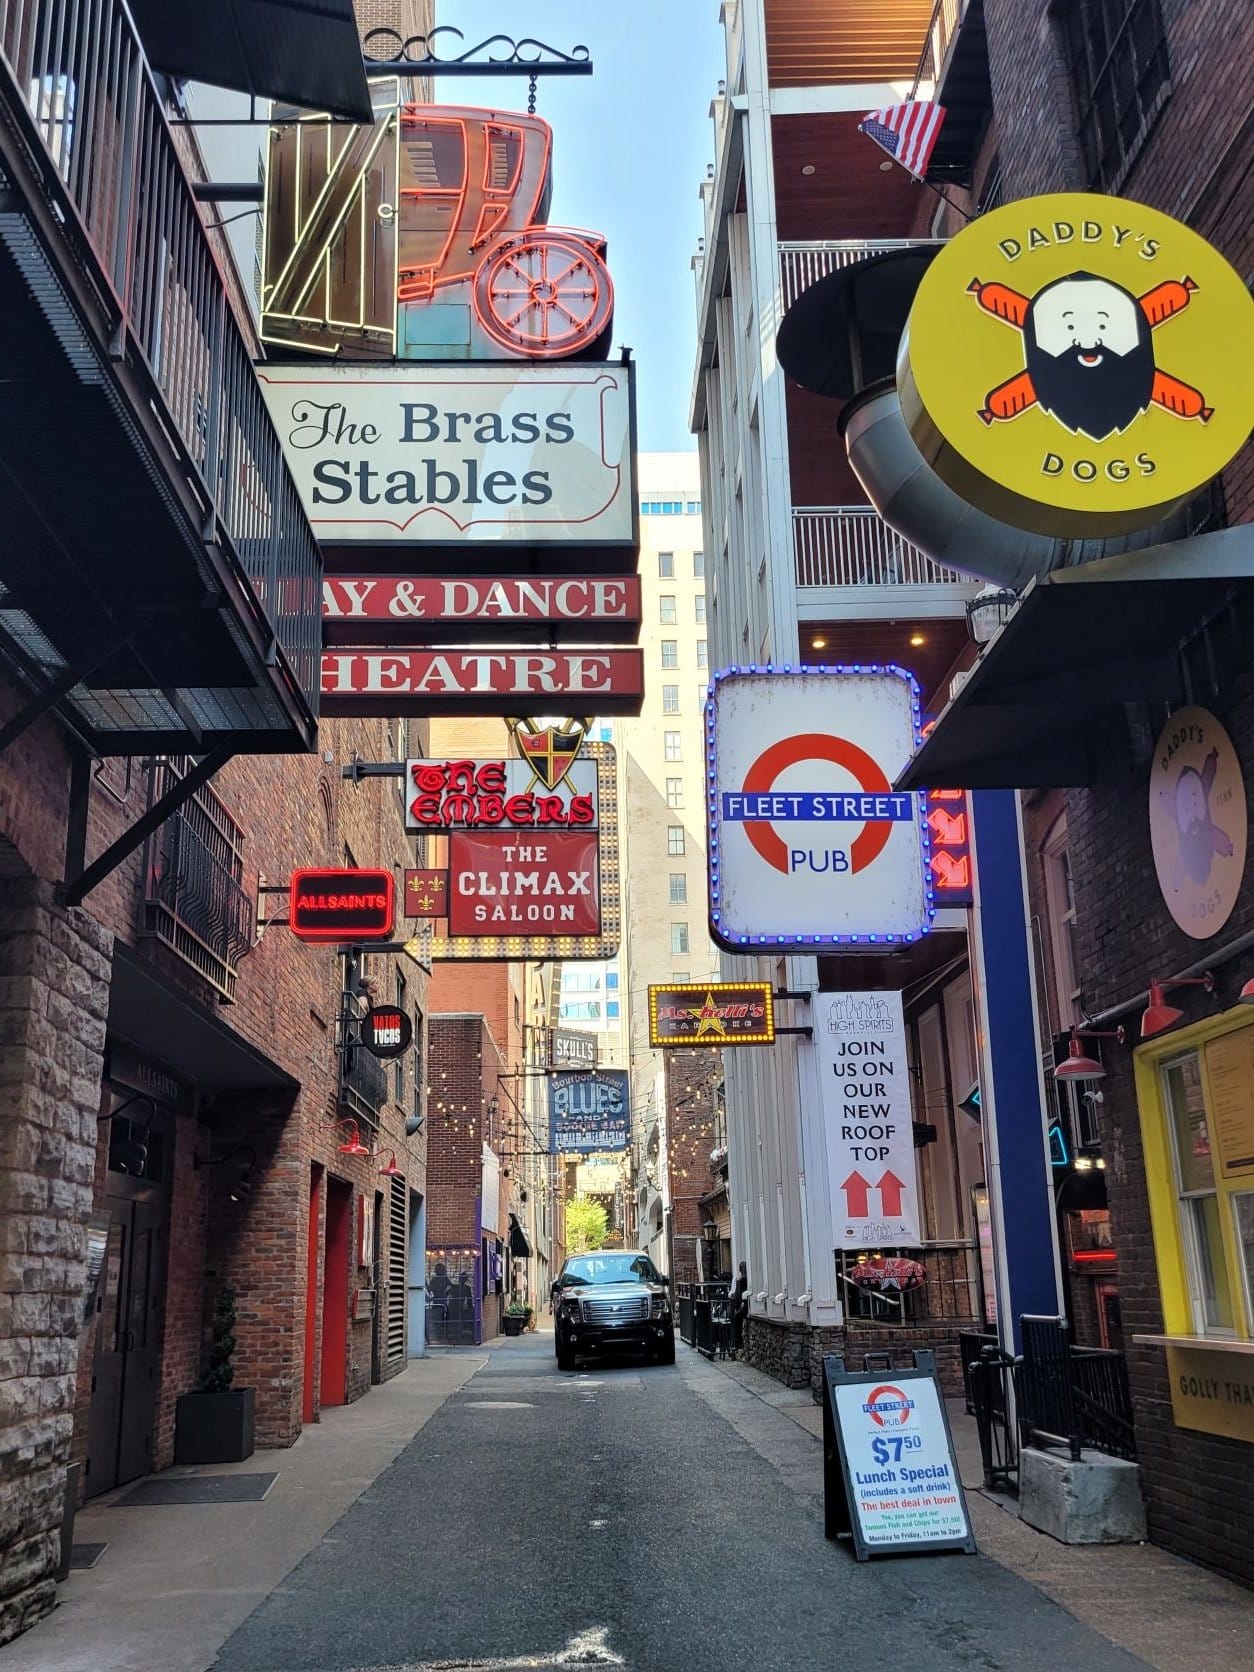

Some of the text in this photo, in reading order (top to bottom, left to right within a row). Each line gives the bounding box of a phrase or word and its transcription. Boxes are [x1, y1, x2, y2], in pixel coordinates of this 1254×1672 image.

[997, 221, 1161, 262] DADDY'S
[289, 400, 574, 449] The Brass
[1041, 452, 1156, 483] DOGS
[312, 458, 553, 505] Stables
[388, 581, 425, 617] &
[440, 581, 626, 617] DANCE
[308, 655, 612, 692] HEATRE
[1161, 724, 1204, 771] DADDY'S
[729, 797, 905, 817] FLEET STREET
[502, 846, 547, 862] THE
[791, 850, 849, 873] PUB
[458, 872, 591, 895] CLIMAX
[298, 895, 386, 910] ALLSAINTS
[474, 905, 575, 921] SALOON
[373, 1015, 401, 1029] VATOS
[830, 1020, 892, 1031] HIGH SPIRITS
[557, 1039, 594, 1061] SKULL'S
[838, 1041, 885, 1057] JOIN
[833, 1062, 894, 1077] US ON
[552, 1073, 592, 1090] Bourbon
[554, 1083, 623, 1114] BLUES
[843, 1083, 888, 1098] OUR
[843, 1104, 891, 1119] NEW
[841, 1125, 896, 1140] ROOF
[850, 1146, 890, 1162] TOP
[1180, 1376, 1254, 1407] GOLLY THA
[864, 1401, 913, 1412] FLEET STREET
[883, 1418, 900, 1426] PUB
[856, 1464, 949, 1485] Lunch Special
[860, 1488, 898, 1499] (includes
[908, 1485, 924, 1494] soft
[926, 1482, 951, 1492] drink)
[861, 1496, 956, 1511] The best deal in town
[914, 1519, 931, 1527] Chips
[932, 1517, 940, 1525] for
[869, 1533, 892, 1541] Monday
[901, 1531, 921, 1539] Friday,
